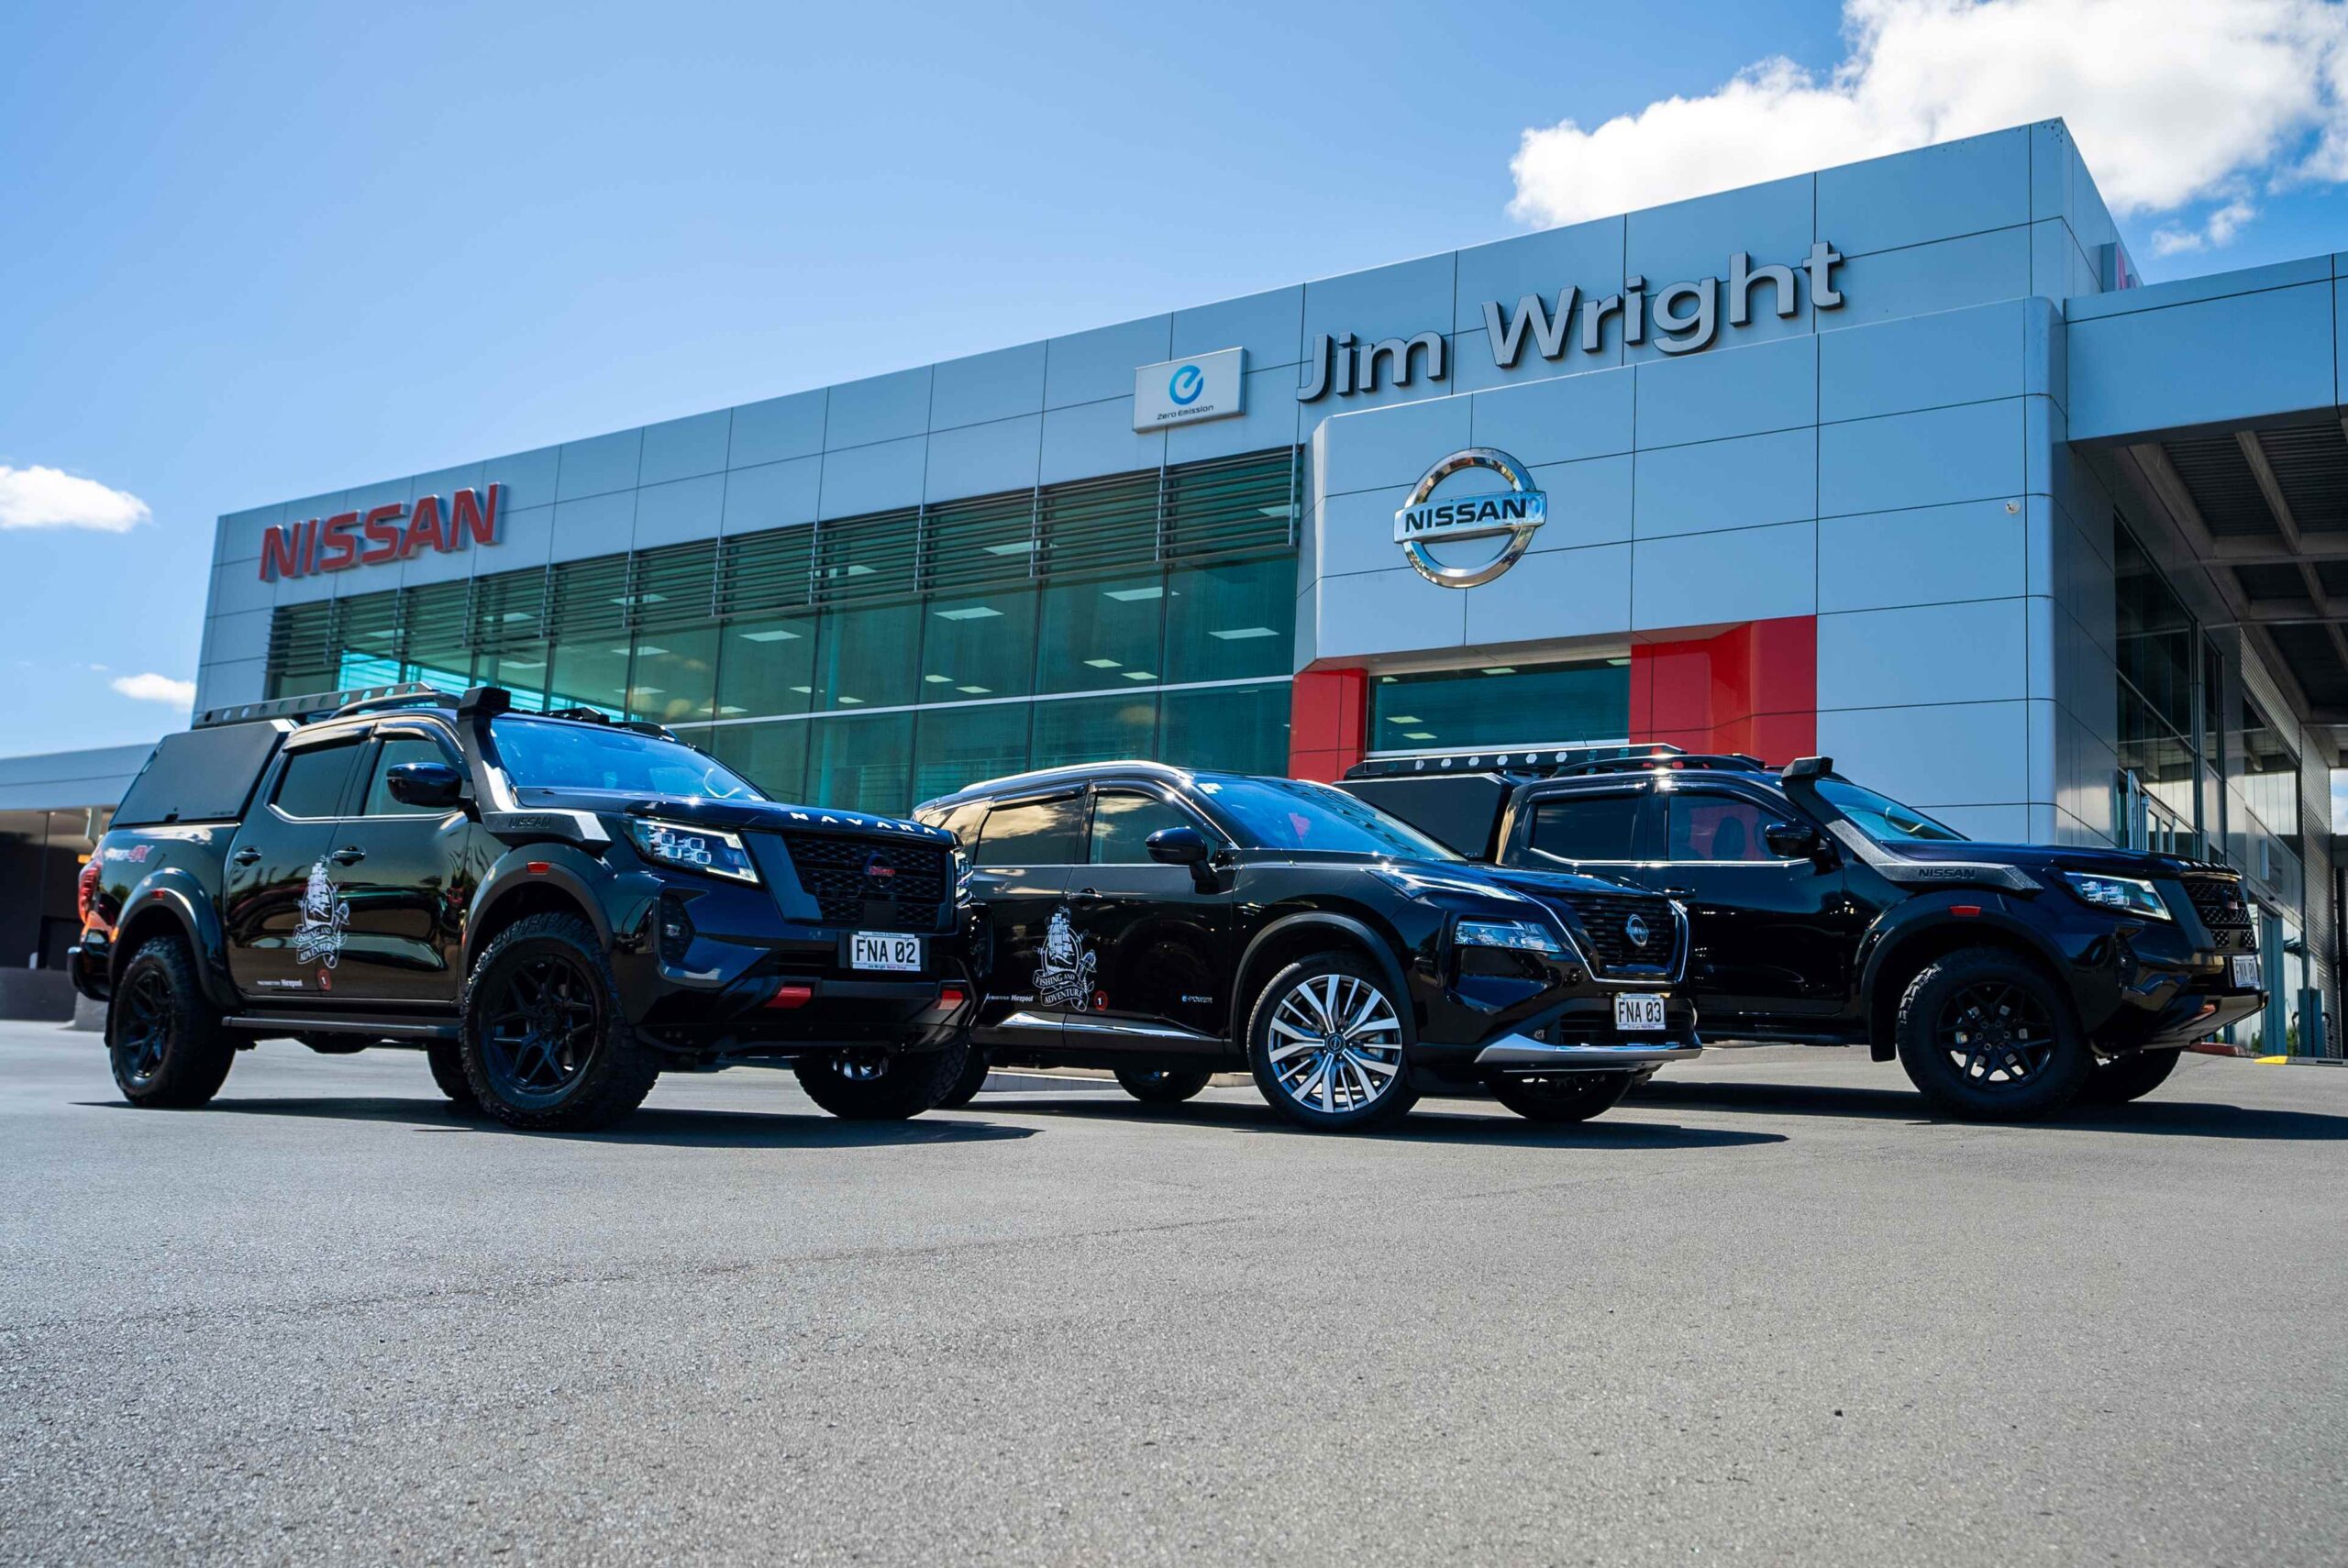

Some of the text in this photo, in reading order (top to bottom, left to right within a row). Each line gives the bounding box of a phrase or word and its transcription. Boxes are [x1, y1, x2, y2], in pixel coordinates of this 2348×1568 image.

[1296, 240, 1844, 403] Jim Wright
[1157, 404, 1214, 421] Zero Emission
[1404, 498, 1528, 535] NISSAN
[259, 481, 503, 582] NISSAN
[508, 816, 551, 828] NISSAN
[790, 812, 938, 835] NAVARA
[1918, 867, 1976, 878] NISSAN
[294, 926, 331, 944] FISHING AND
[299, 943, 337, 962] ADVENTURE
[856, 938, 916, 964] FNA 02
[1035, 973, 1076, 987] FISHING AND
[1011, 994, 1034, 1002] Hirepool
[1044, 988, 1084, 1004] ADVENTURE
[1097, 997, 1102, 1006] 1
[1618, 1001, 1662, 1023] FNA 03
